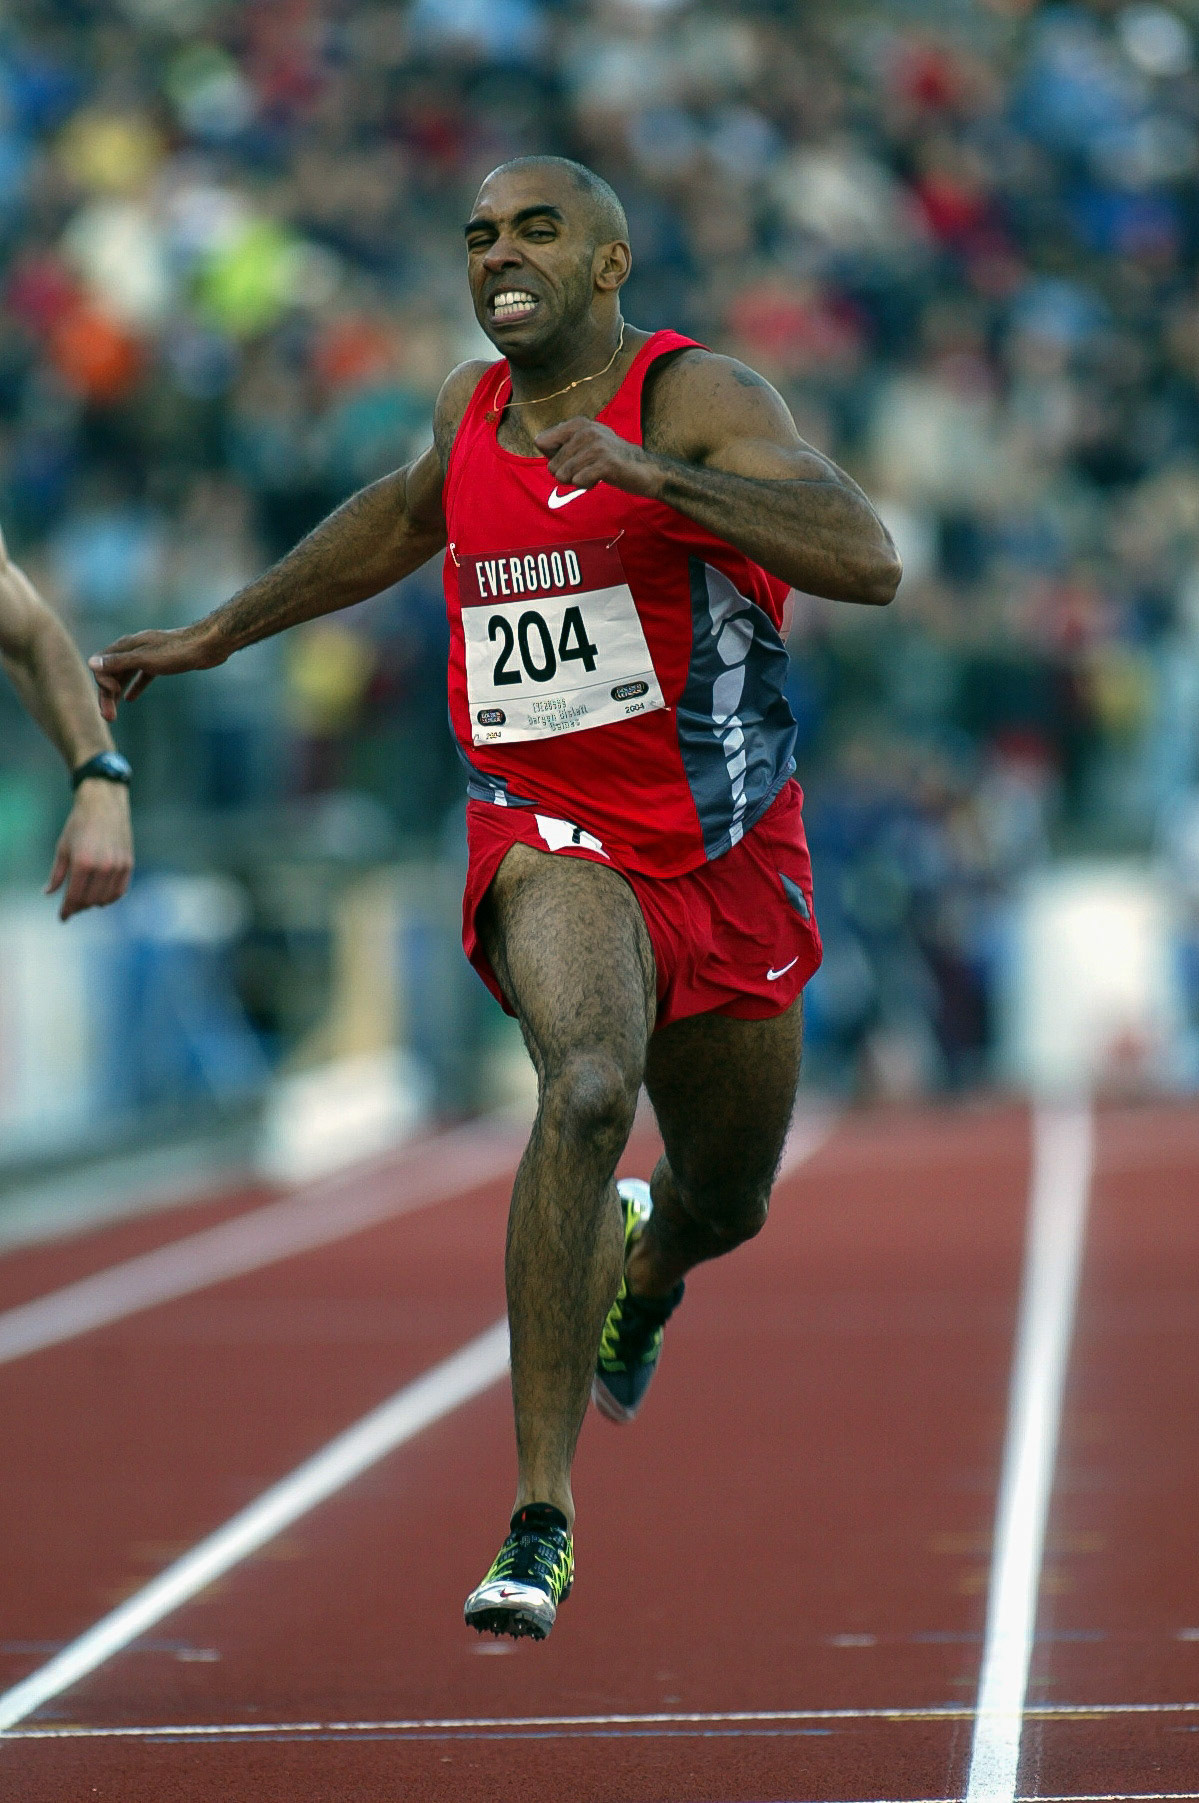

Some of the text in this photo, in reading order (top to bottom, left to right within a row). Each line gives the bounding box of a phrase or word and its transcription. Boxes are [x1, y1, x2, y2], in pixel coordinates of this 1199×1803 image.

[475, 549, 581, 598] EVERGOOD
[487, 605, 599, 687] 204
[624, 702, 645, 714] 2004
